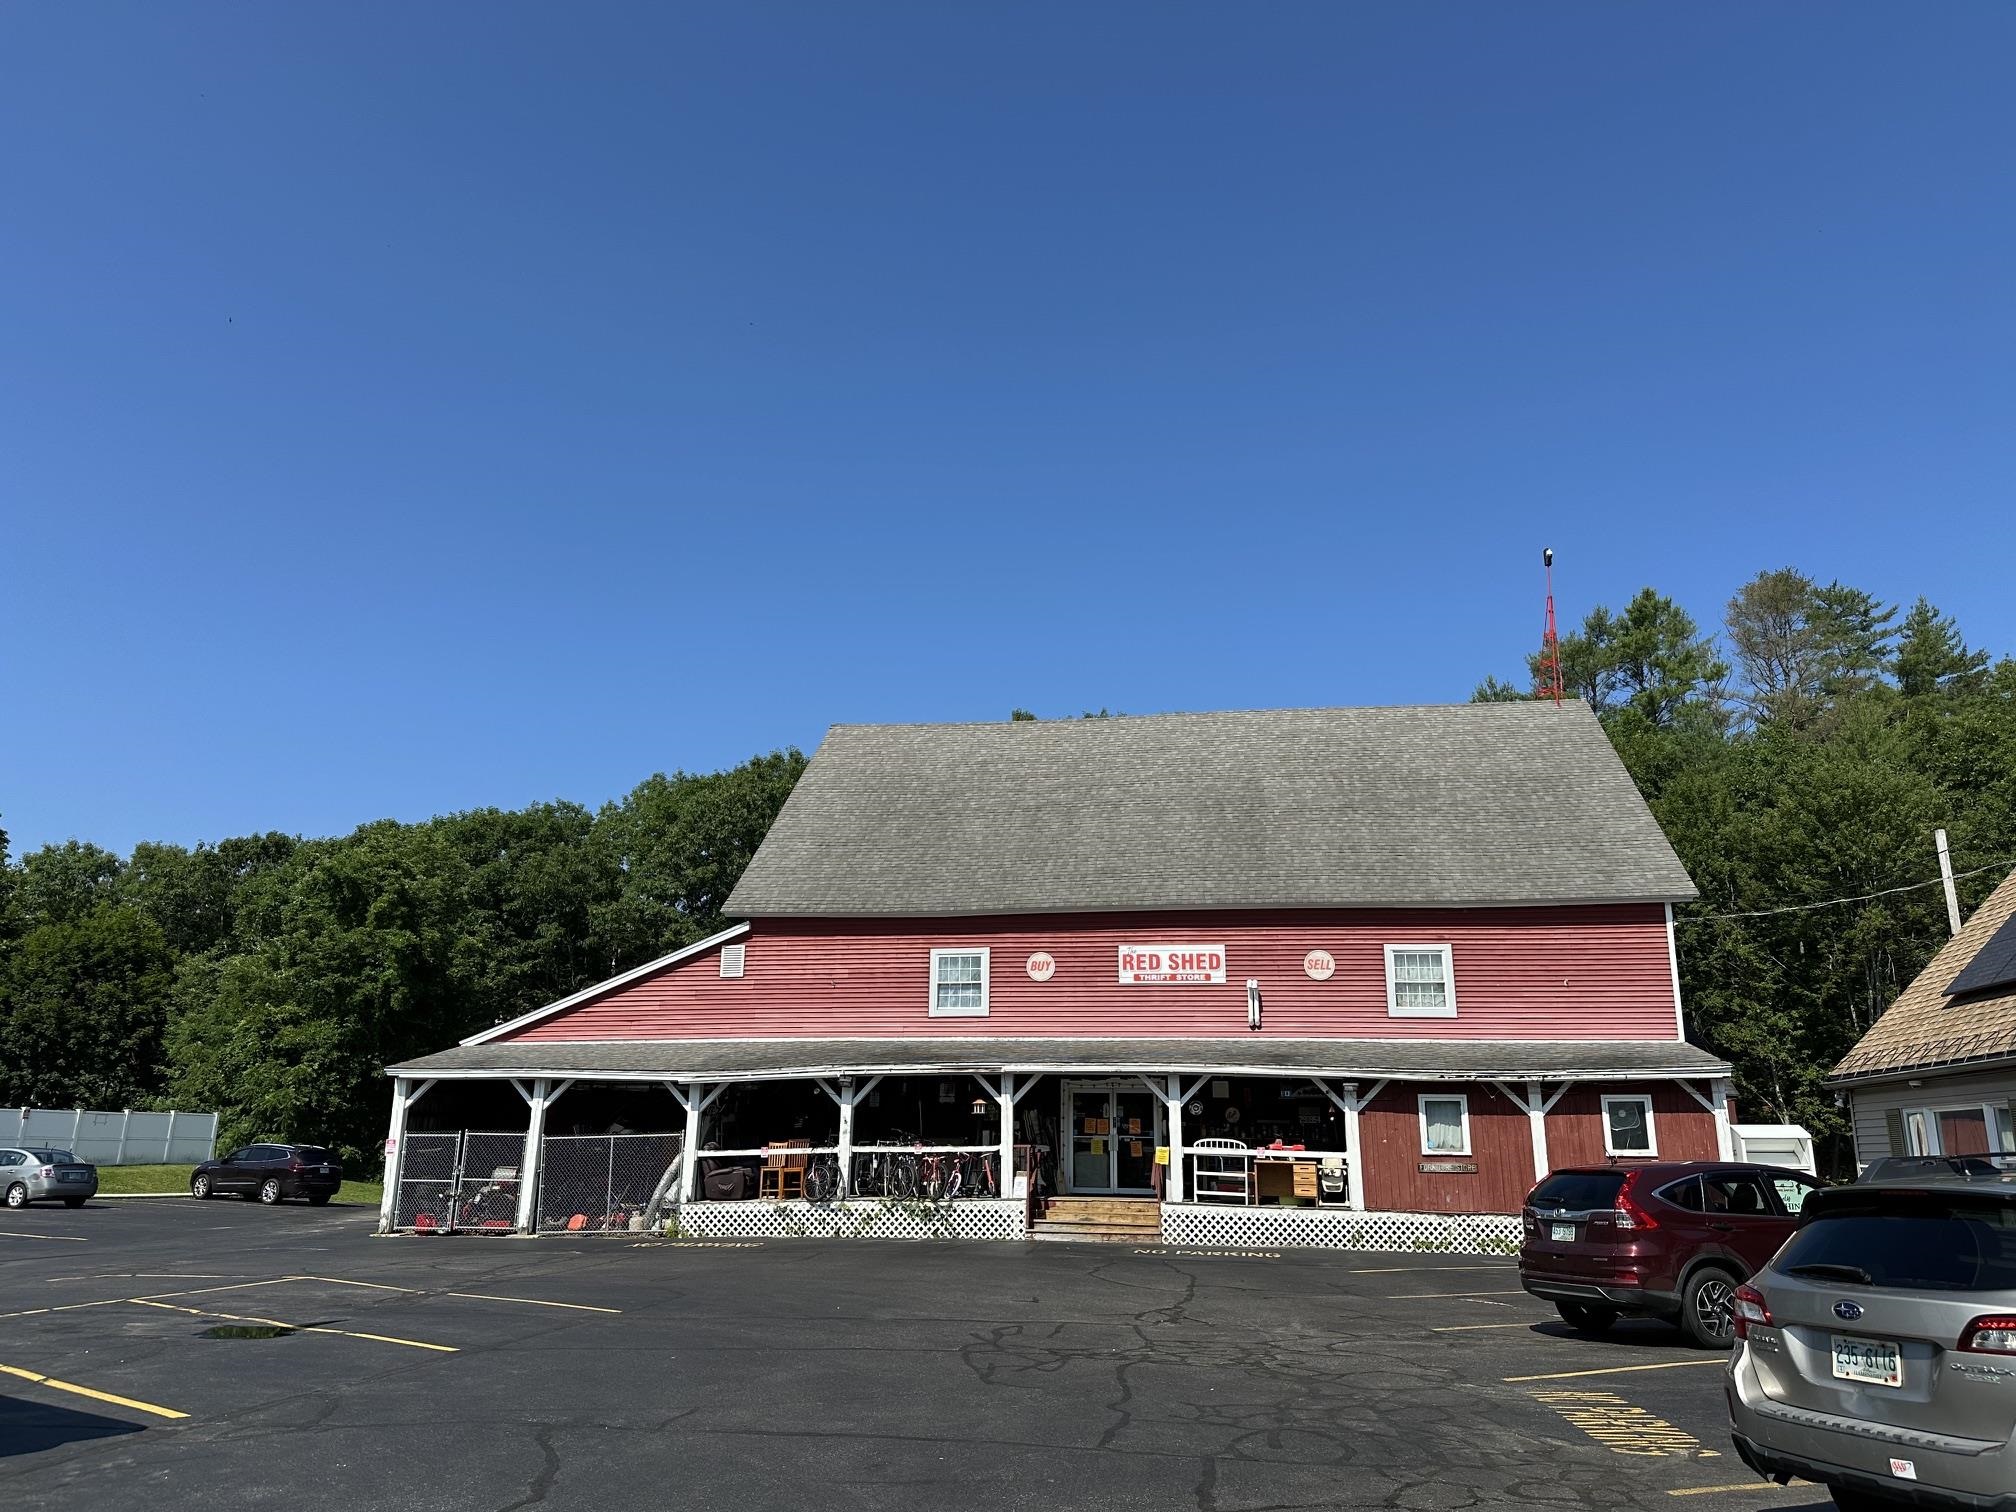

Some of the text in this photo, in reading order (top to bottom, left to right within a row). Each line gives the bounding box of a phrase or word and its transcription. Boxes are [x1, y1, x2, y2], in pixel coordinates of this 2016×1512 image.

[1030, 960, 1051, 971] BUY
[1122, 953, 1221, 971] RED SHED
[1307, 959, 1331, 970] SELL
[1176, 1250, 1281, 1258] PARKING
[1836, 1343, 1859, 1366] 235
[1950, 1363, 2016, 1376] OUTBACK
